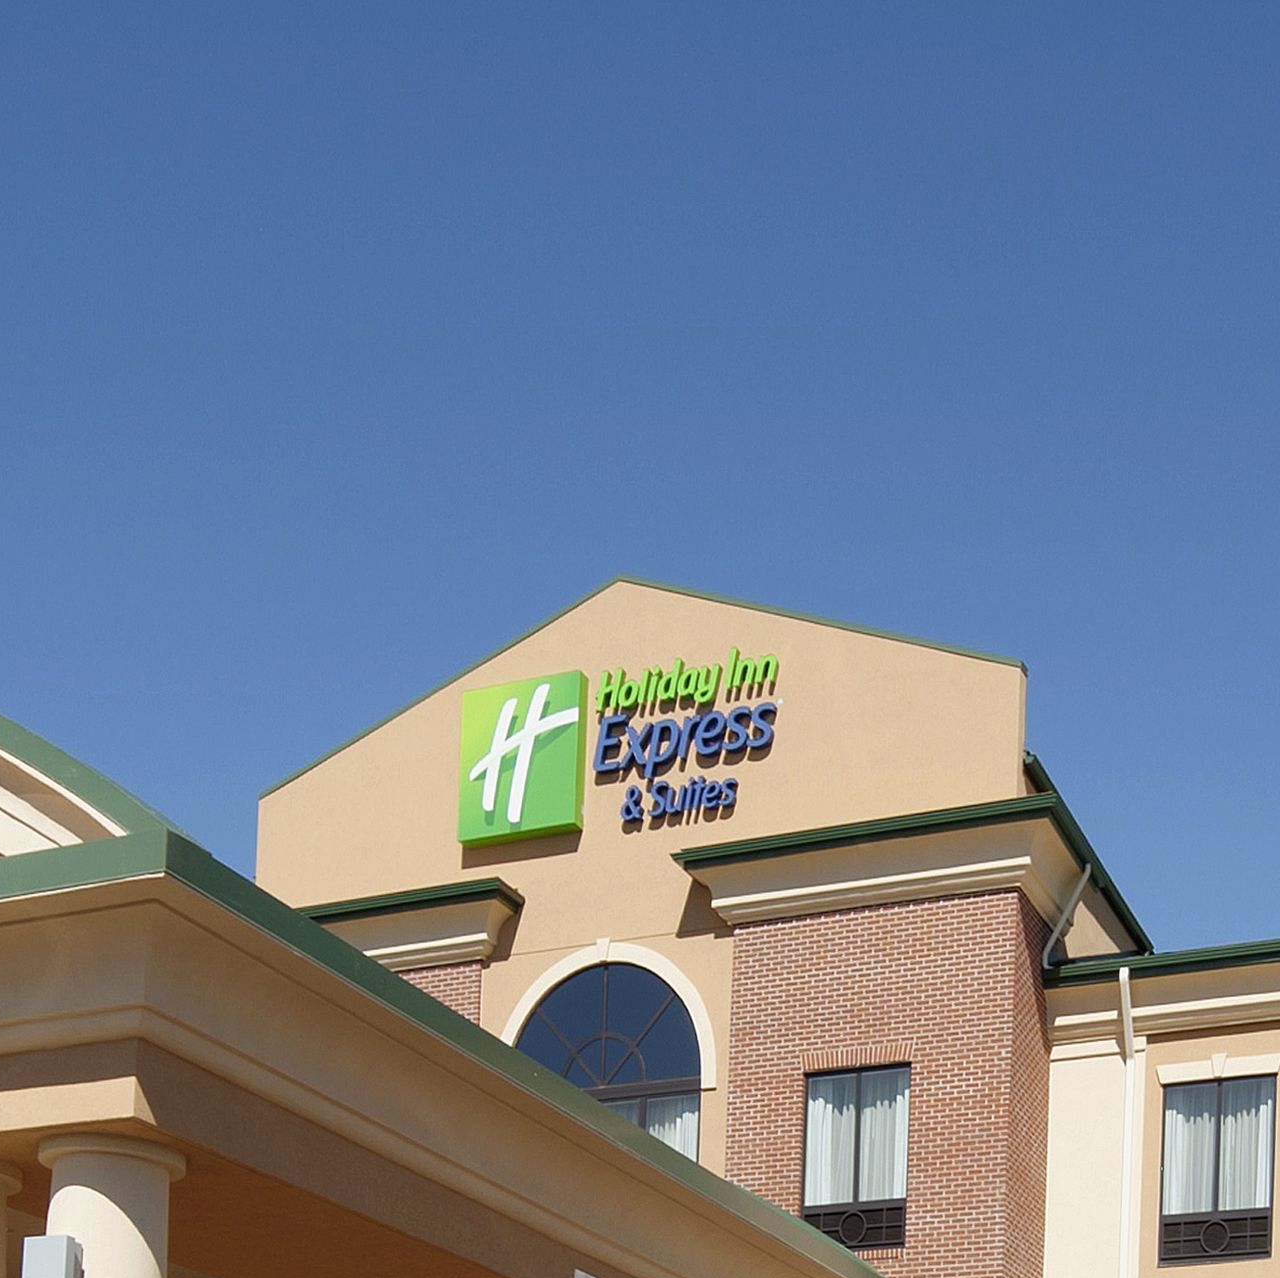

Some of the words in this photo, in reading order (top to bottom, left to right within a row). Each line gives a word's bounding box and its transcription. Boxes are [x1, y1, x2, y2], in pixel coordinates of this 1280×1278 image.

[595, 657, 721, 713] Holiday
[725, 647, 779, 689] Inn
[592, 702, 777, 779] Express
[621, 790, 644, 821] &
[648, 776, 738, 817] Suites
